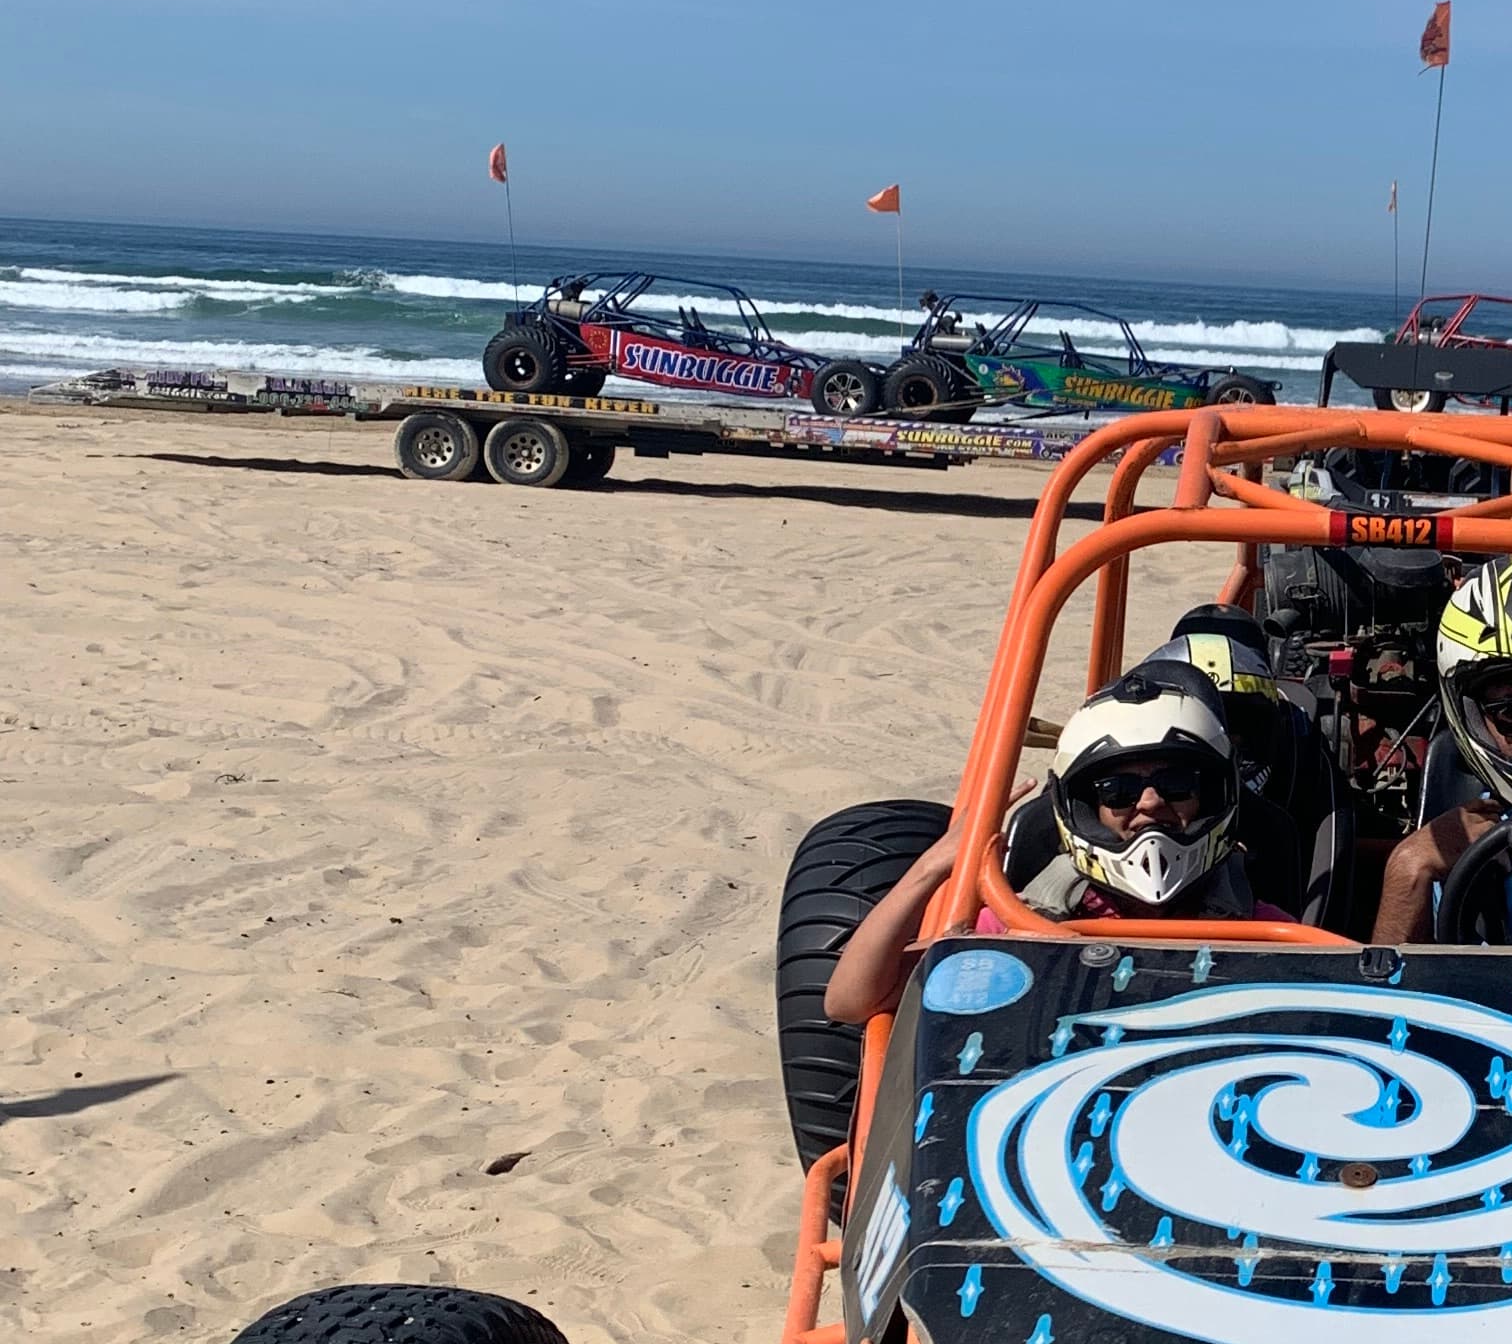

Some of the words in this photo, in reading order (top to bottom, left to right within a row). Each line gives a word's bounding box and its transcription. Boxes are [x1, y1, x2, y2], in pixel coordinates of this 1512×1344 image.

[623, 343, 779, 393] SUNBUGGIE
[476, 389, 515, 404] THE
[528, 393, 572, 408] FUN
[1064, 375, 1177, 409] SUNBUGGIE
[1351, 516, 1431, 545] SB412
